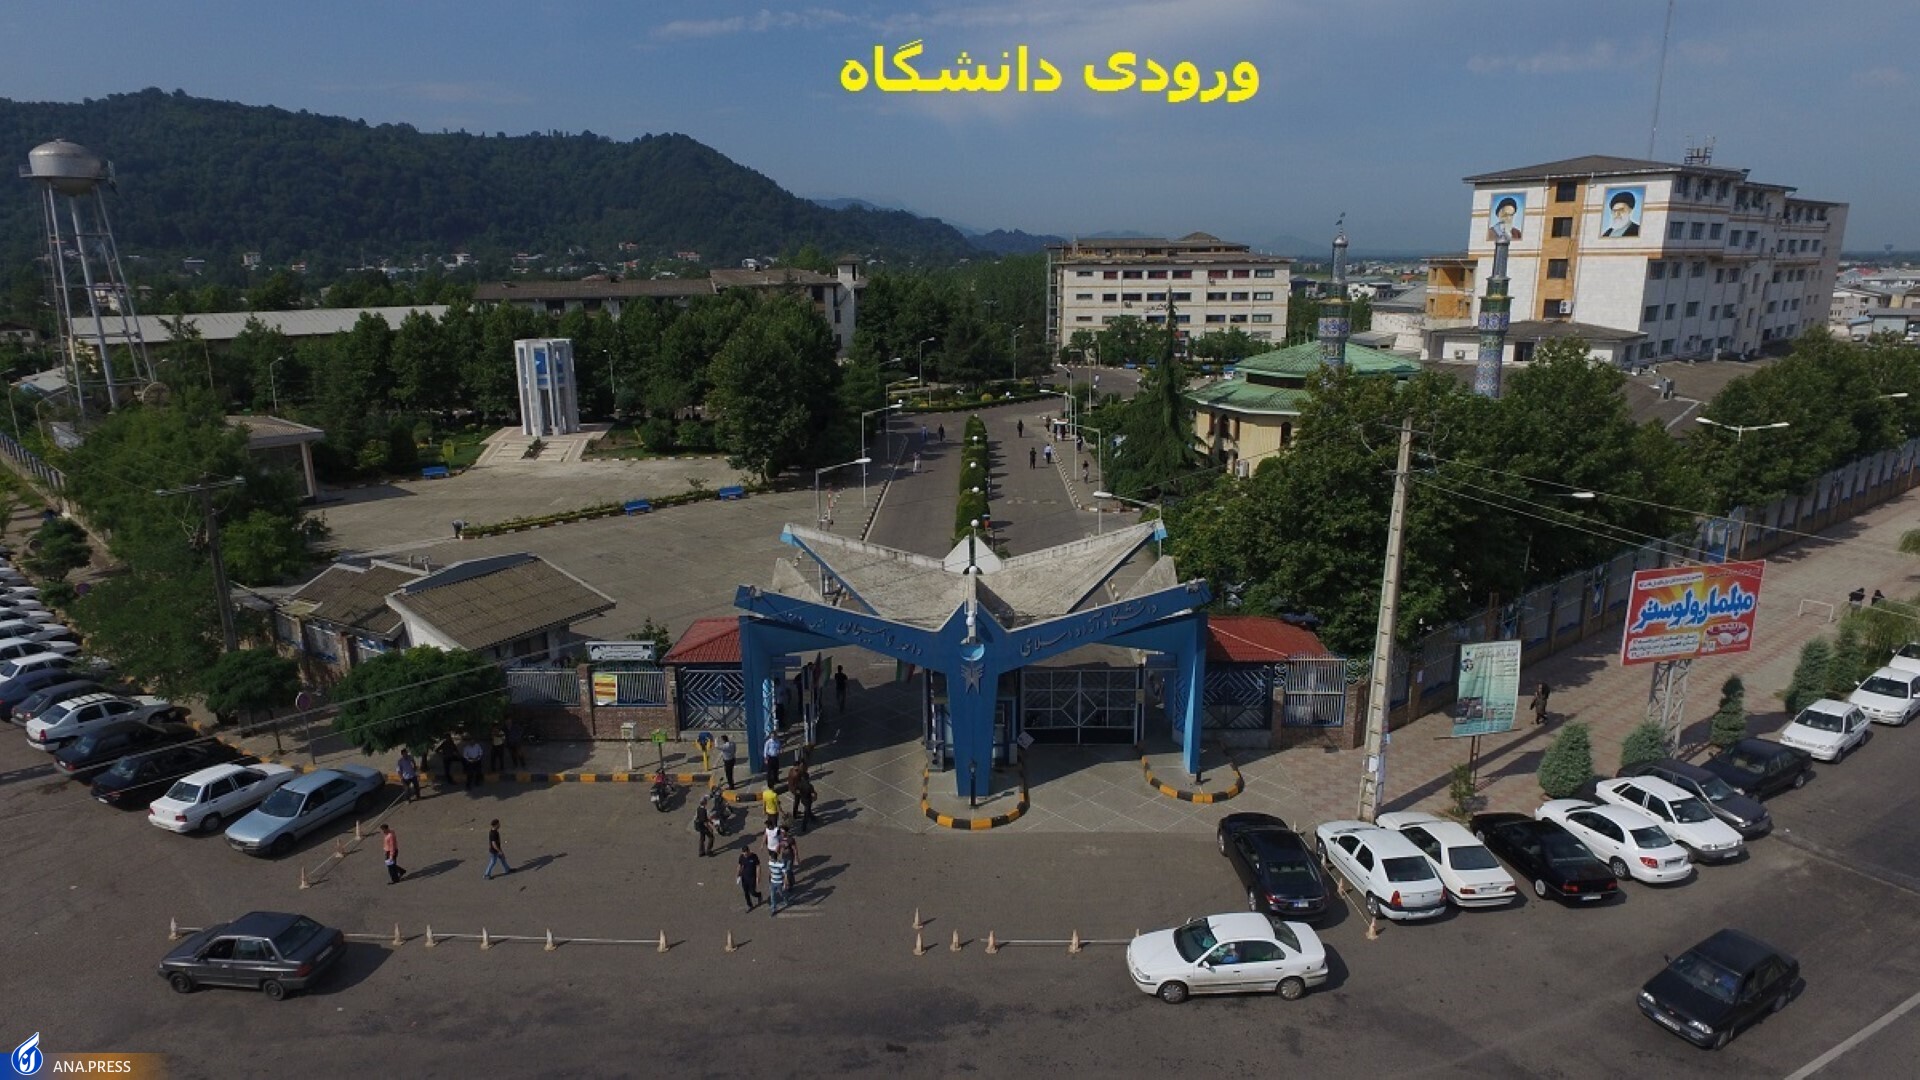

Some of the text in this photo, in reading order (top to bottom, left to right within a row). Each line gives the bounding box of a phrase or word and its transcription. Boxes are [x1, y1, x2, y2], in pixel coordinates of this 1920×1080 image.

[1697, 584, 1755, 624] مبلمان
[895, 640, 924, 657] واحد
[1018, 599, 1160, 658] دانشگاه آزاد اسلامی
